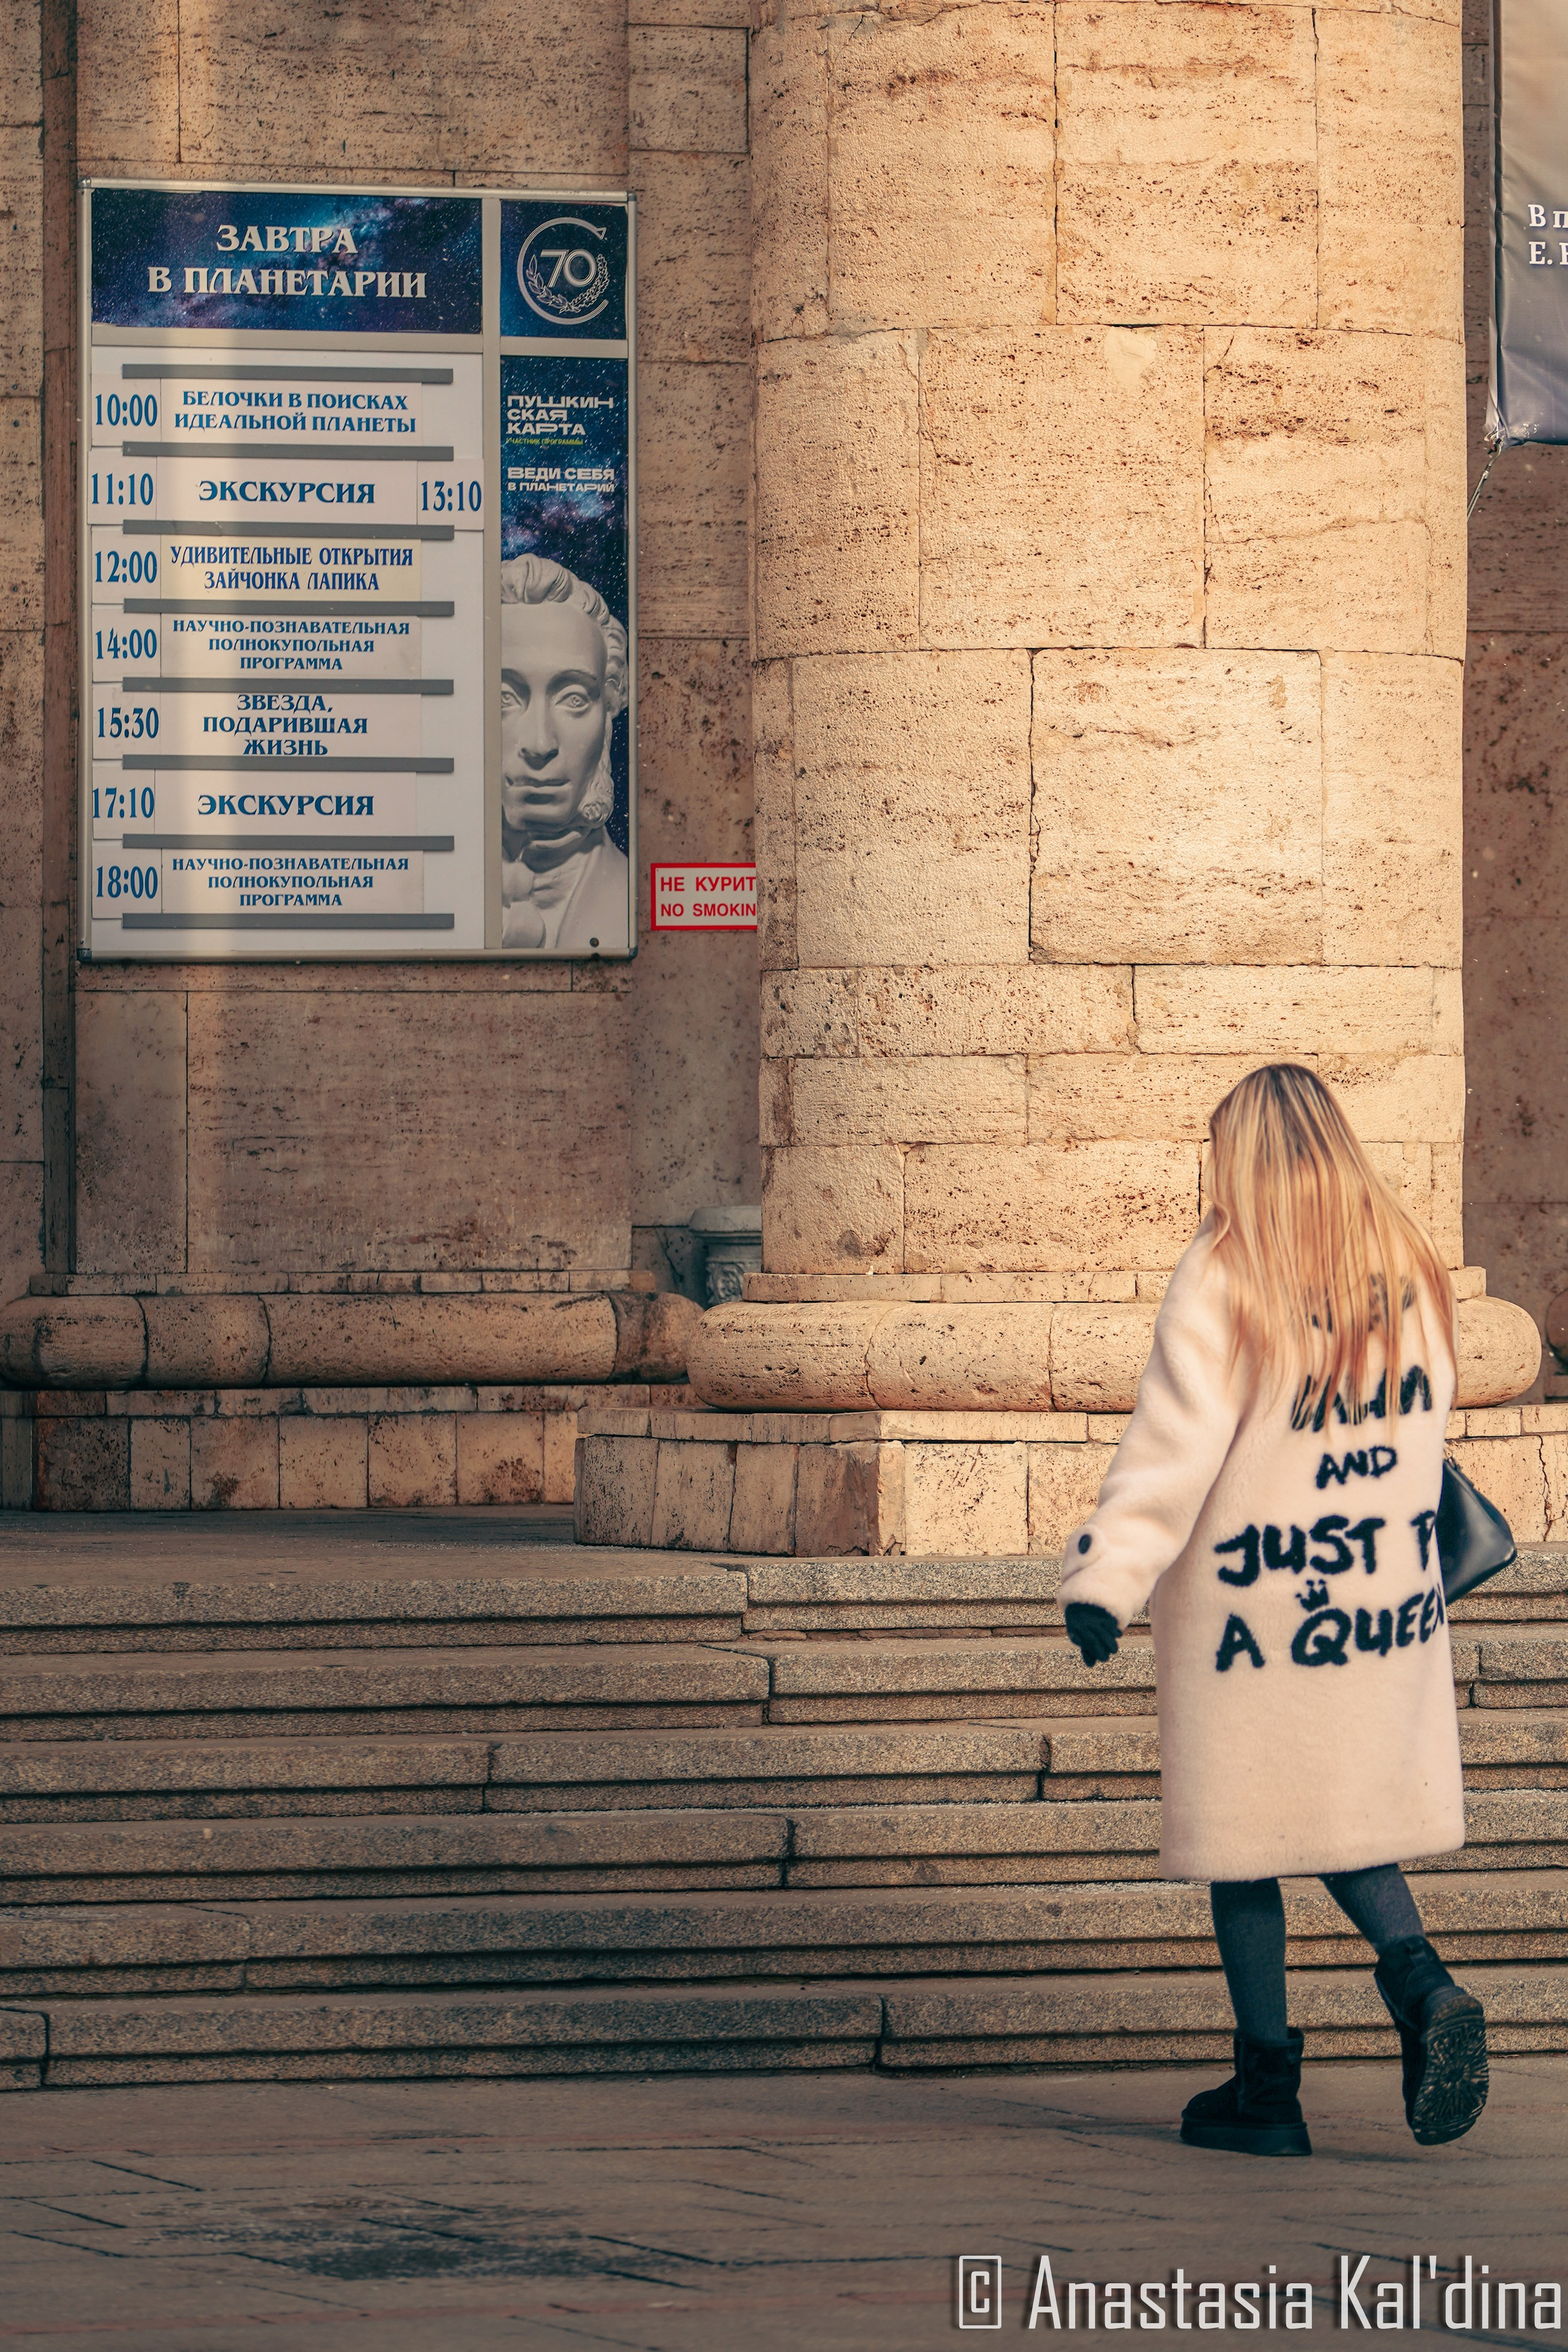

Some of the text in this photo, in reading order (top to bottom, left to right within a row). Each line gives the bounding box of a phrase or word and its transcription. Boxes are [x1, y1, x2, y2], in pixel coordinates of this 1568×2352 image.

[1528, 204, 1547, 227] В
[217, 225, 358, 253] ЗАВТРА
[540, 249, 597, 288] 70
[148, 267, 426, 297] В ПЛАНЕТАРИИ
[184, 391, 407, 409] БЕЛОЧКИ В ПОИСКАХ
[507, 395, 614, 409] ПУШКИН
[96, 394, 157, 426] 10:00
[507, 409, 568, 421] СКАЯ
[175, 412, 415, 432] ИДЕАЛЬНОЙ ПЛАНЕТЫ
[507, 423, 586, 435] КАРТА
[507, 467, 615, 481] ВЕДИ СЕБЯ
[92, 473, 153, 505] 11:10
[200, 481, 375, 503] ЭКСКУРСИЯ
[422, 481, 481, 511] 13:10
[507, 482, 615, 492] В ПЛАНЕТАРИЙ
[171, 547, 412, 565] УДИВИТЕЛЬНЫЕ ОТКРЫТИЯ
[96, 551, 157, 583] 12:00
[205, 572, 379, 590] ЗАЙЧОНКА ЛАПИКА
[174, 620, 409, 634] НАУЧНО-ПОЗНАВАТЕЛЬНАЯ
[96, 628, 157, 659] 14:00
[209, 639, 374, 652] ПОЛНОКУПОЛЬНАЯ
[241, 657, 342, 669] ПРОГРАММА
[238, 695, 333, 714] ЗВЕЗДА,
[98, 707, 159, 738] 15:30
[204, 717, 367, 735] ПОДАРИВШАЯ
[243, 740, 328, 755] ЖИЗНЬ
[93, 787, 154, 818] 17:10
[198, 795, 374, 815] ЭКСКУРСИЯ
[173, 858, 408, 870] НАУЧНО-ПОЗНАВАТЕЛЬНАЯ
[96, 865, 157, 899] 18:00
[209, 876, 373, 888] ПОЛНОКУПОЛЬНАЯ
[661, 877, 756, 891] НЕ КУРИТ
[240, 894, 342, 906] ПРОГРАММА
[661, 903, 756, 917] NO SMOKIN
[1316, 1446, 1397, 1489] AND
[1215, 1515, 1385, 1586] JUST
[1216, 1614, 1265, 1672] A
